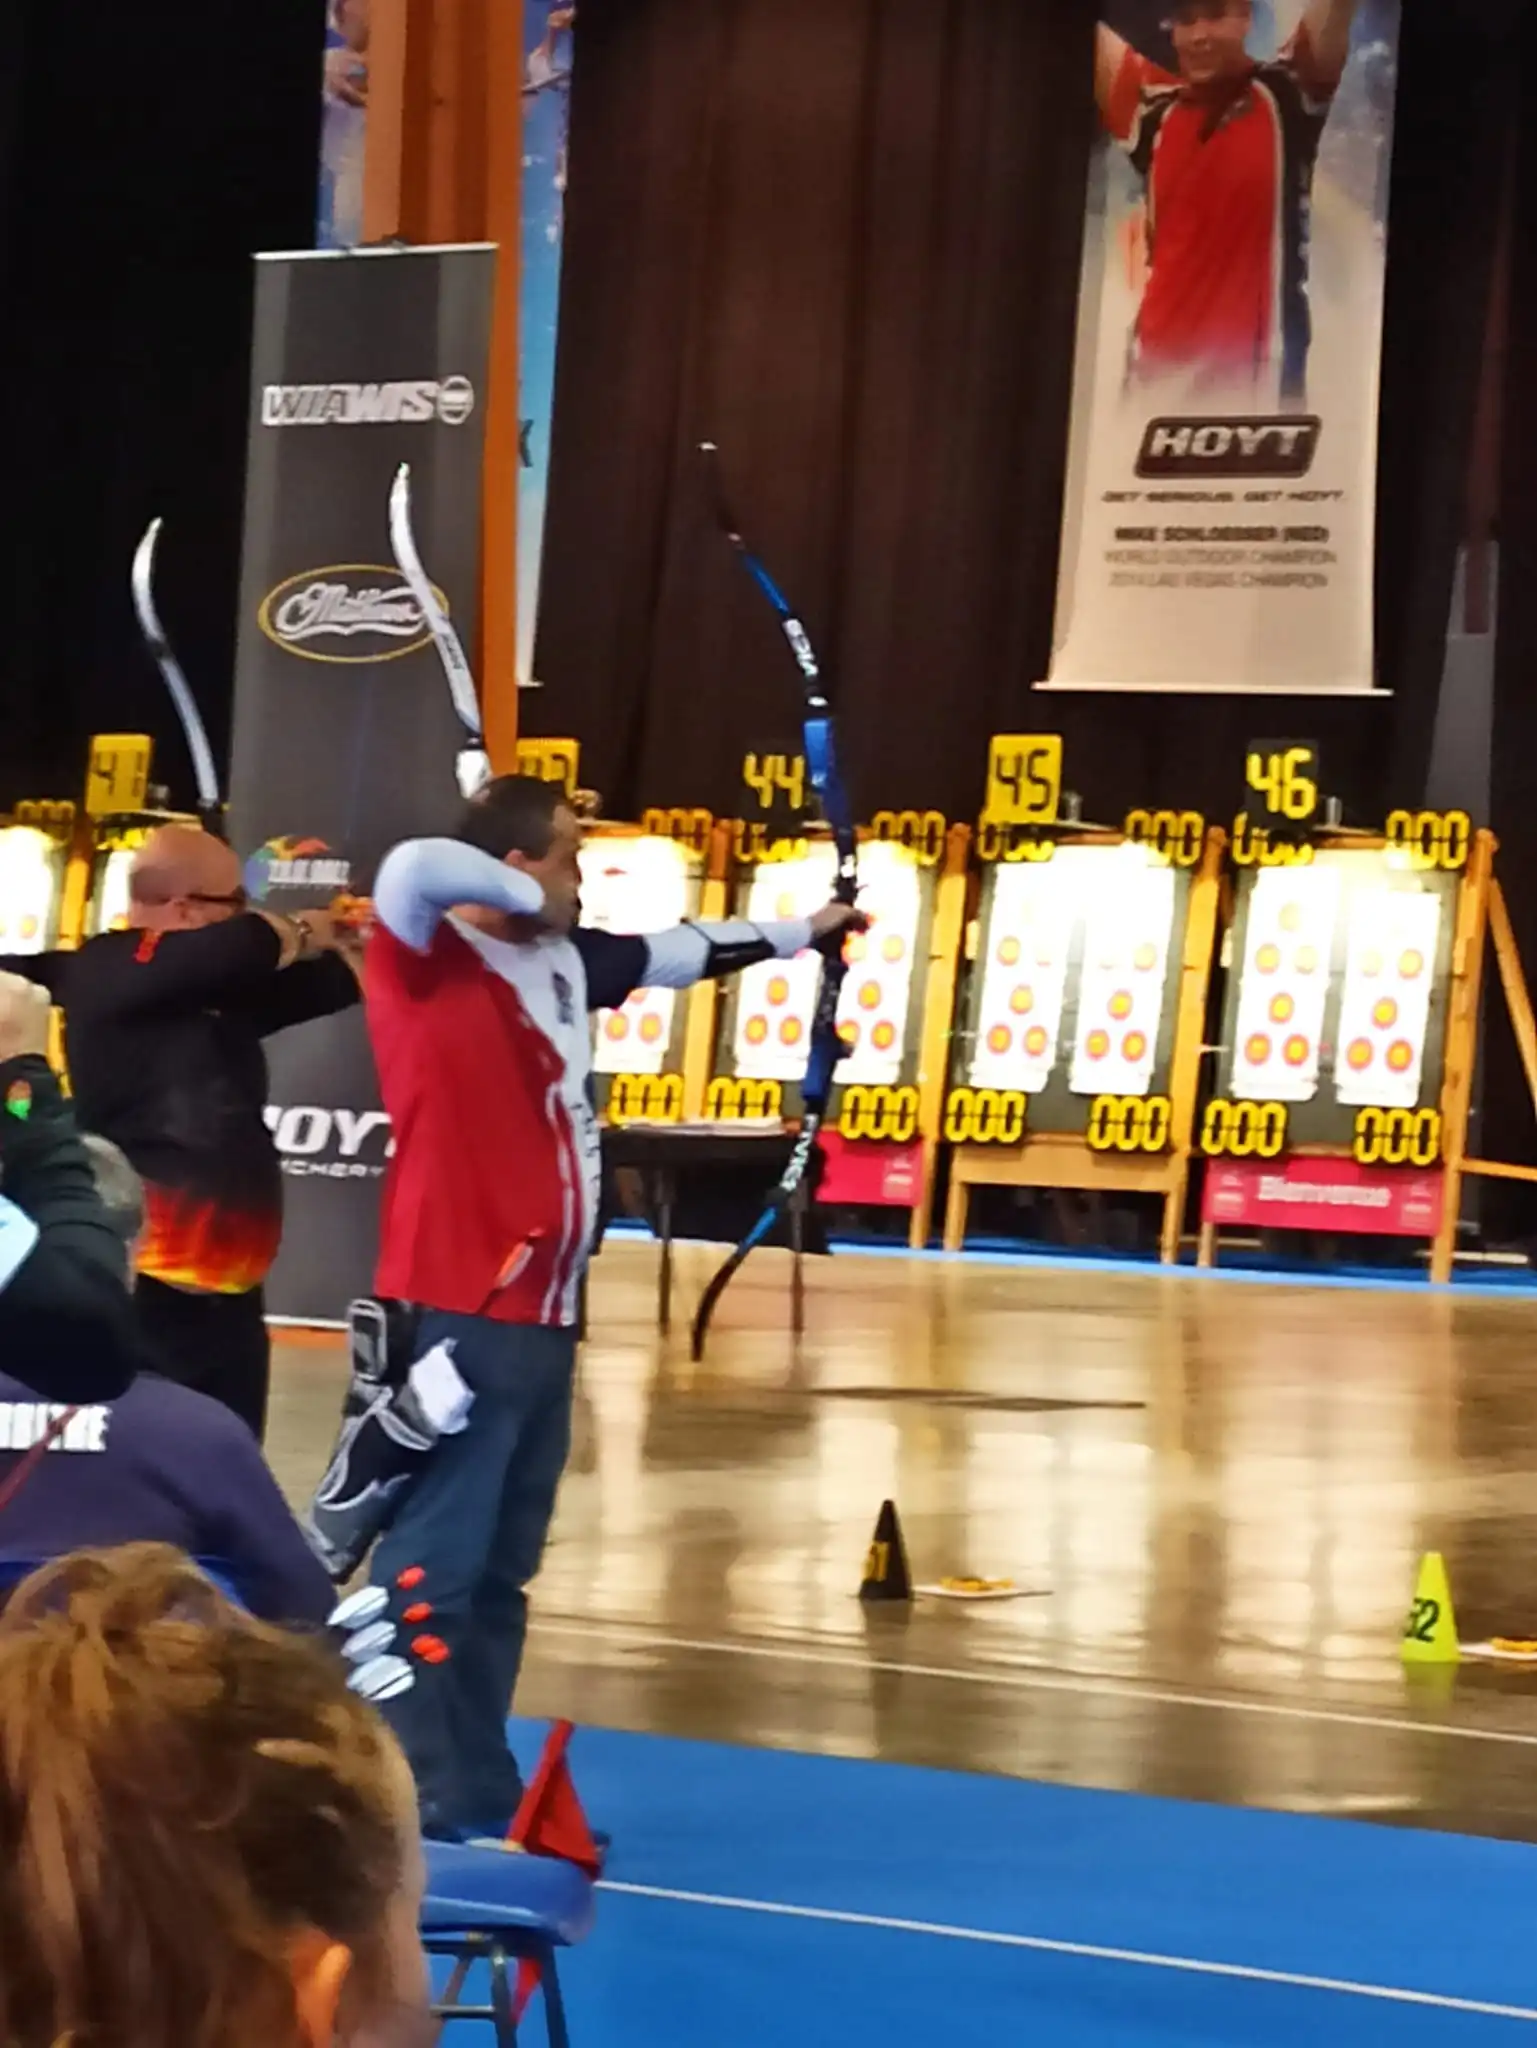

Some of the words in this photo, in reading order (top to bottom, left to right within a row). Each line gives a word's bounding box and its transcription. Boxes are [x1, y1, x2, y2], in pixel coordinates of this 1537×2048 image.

[1149, 425, 1311, 457] HOYT
[743, 752, 804, 809] 44
[996, 748, 1052, 812] 45
[1246, 747, 1317, 819] 46
[841, 1086, 919, 1141] 000
[945, 1087, 1027, 1143] 000
[1088, 1094, 1170, 1151] 000
[1201, 1099, 1287, 1157] 000
[1355, 1107, 1441, 1166] 000
